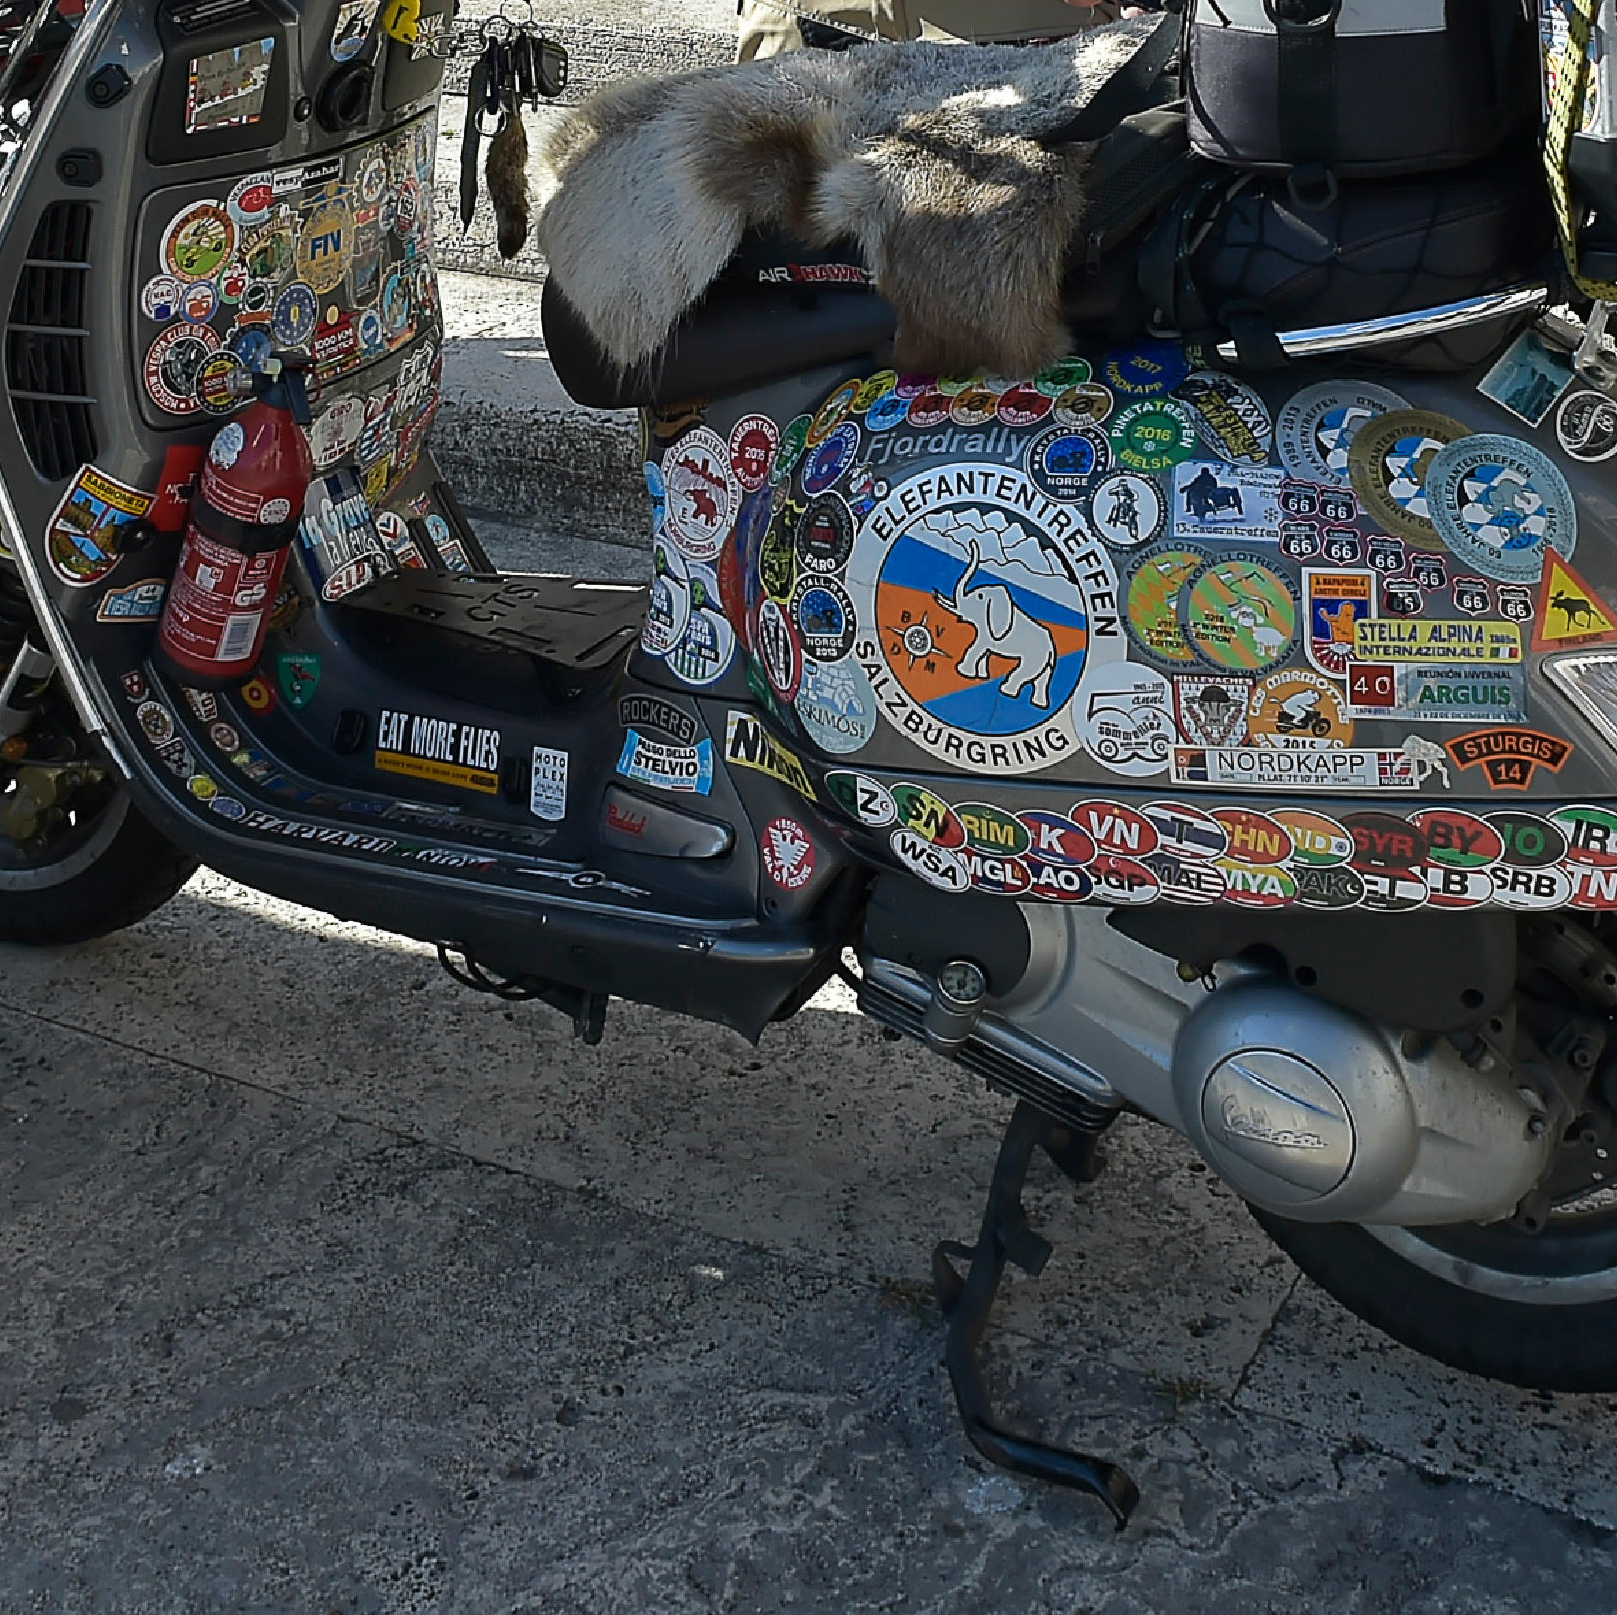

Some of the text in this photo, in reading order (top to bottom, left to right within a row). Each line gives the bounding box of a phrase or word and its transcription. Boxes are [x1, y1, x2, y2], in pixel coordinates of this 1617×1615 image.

[310, 228, 343, 261] FIV
[759, 267, 793, 283] AIR
[1129, 355, 1165, 375] 2017
[1106, 361, 1165, 395] NORDKAPP
[1111, 399, 1196, 449] PINETATREFFEN
[865, 426, 1028, 467] Fjordrally
[1120, 448, 1173, 469] BIELSA
[1047, 476, 1089, 487] NORGE
[1445, 454, 1533, 511] ELEFANTENTREFFEN
[1288, 499, 1310, 512] 66
[1326, 504, 1348, 518] 66
[1451, 513, 1487, 549] JAHRE
[870, 470, 1119, 640] ELEFANTENTREFFEN
[1290, 540, 1312, 554] 66
[1331, 544, 1352, 559] 66
[803, 552, 837, 571] FARO
[1376, 554, 1397, 569] 66
[1188, 551, 1302, 602] AGNELLOTREFFEN
[1419, 572, 1440, 586] 66
[235, 583, 267, 606] GS
[1463, 595, 1483, 609] 66
[1507, 603, 1526, 618] 66
[805, 637, 844, 648] NORGE
[1358, 622, 1418, 643] STELLA
[1427, 624, 1485, 643] ALPINA
[1359, 645, 1485, 658] INTERNAZIONALE
[1174, 675, 1254, 685] MILLEVACHES
[1463, 669, 1513, 680] INVERNAL
[855, 640, 1072, 769] SALZBURGRING
[1418, 684, 1512, 706] ARGUIS
[621, 700, 693, 745] ROCKERS
[378, 710, 409, 752] EAT
[410, 715, 457, 762] MORE
[458, 725, 500, 772] FLIES
[665, 746, 696, 759] DELLO
[1462, 734, 1552, 761] STURGIS
[534, 752, 567, 768] MOTO
[633, 751, 699, 778] STELVIO
[1217, 750, 1366, 775] NORDKAPP
[1495, 762, 1523, 780] 14
[534, 768, 566, 783] PLEX
[902, 792, 951, 838] SN
[246, 811, 398, 854] HARVARD
[1086, 810, 1141, 850] VN
[1165, 819, 1194, 844] T
[1426, 820, 1484, 856] BY
[1571, 818, 1612, 858] IR
[1353, 827, 1416, 860] SYR
[899, 834, 960, 887] WSA
[1494, 868, 1558, 898] SRB
